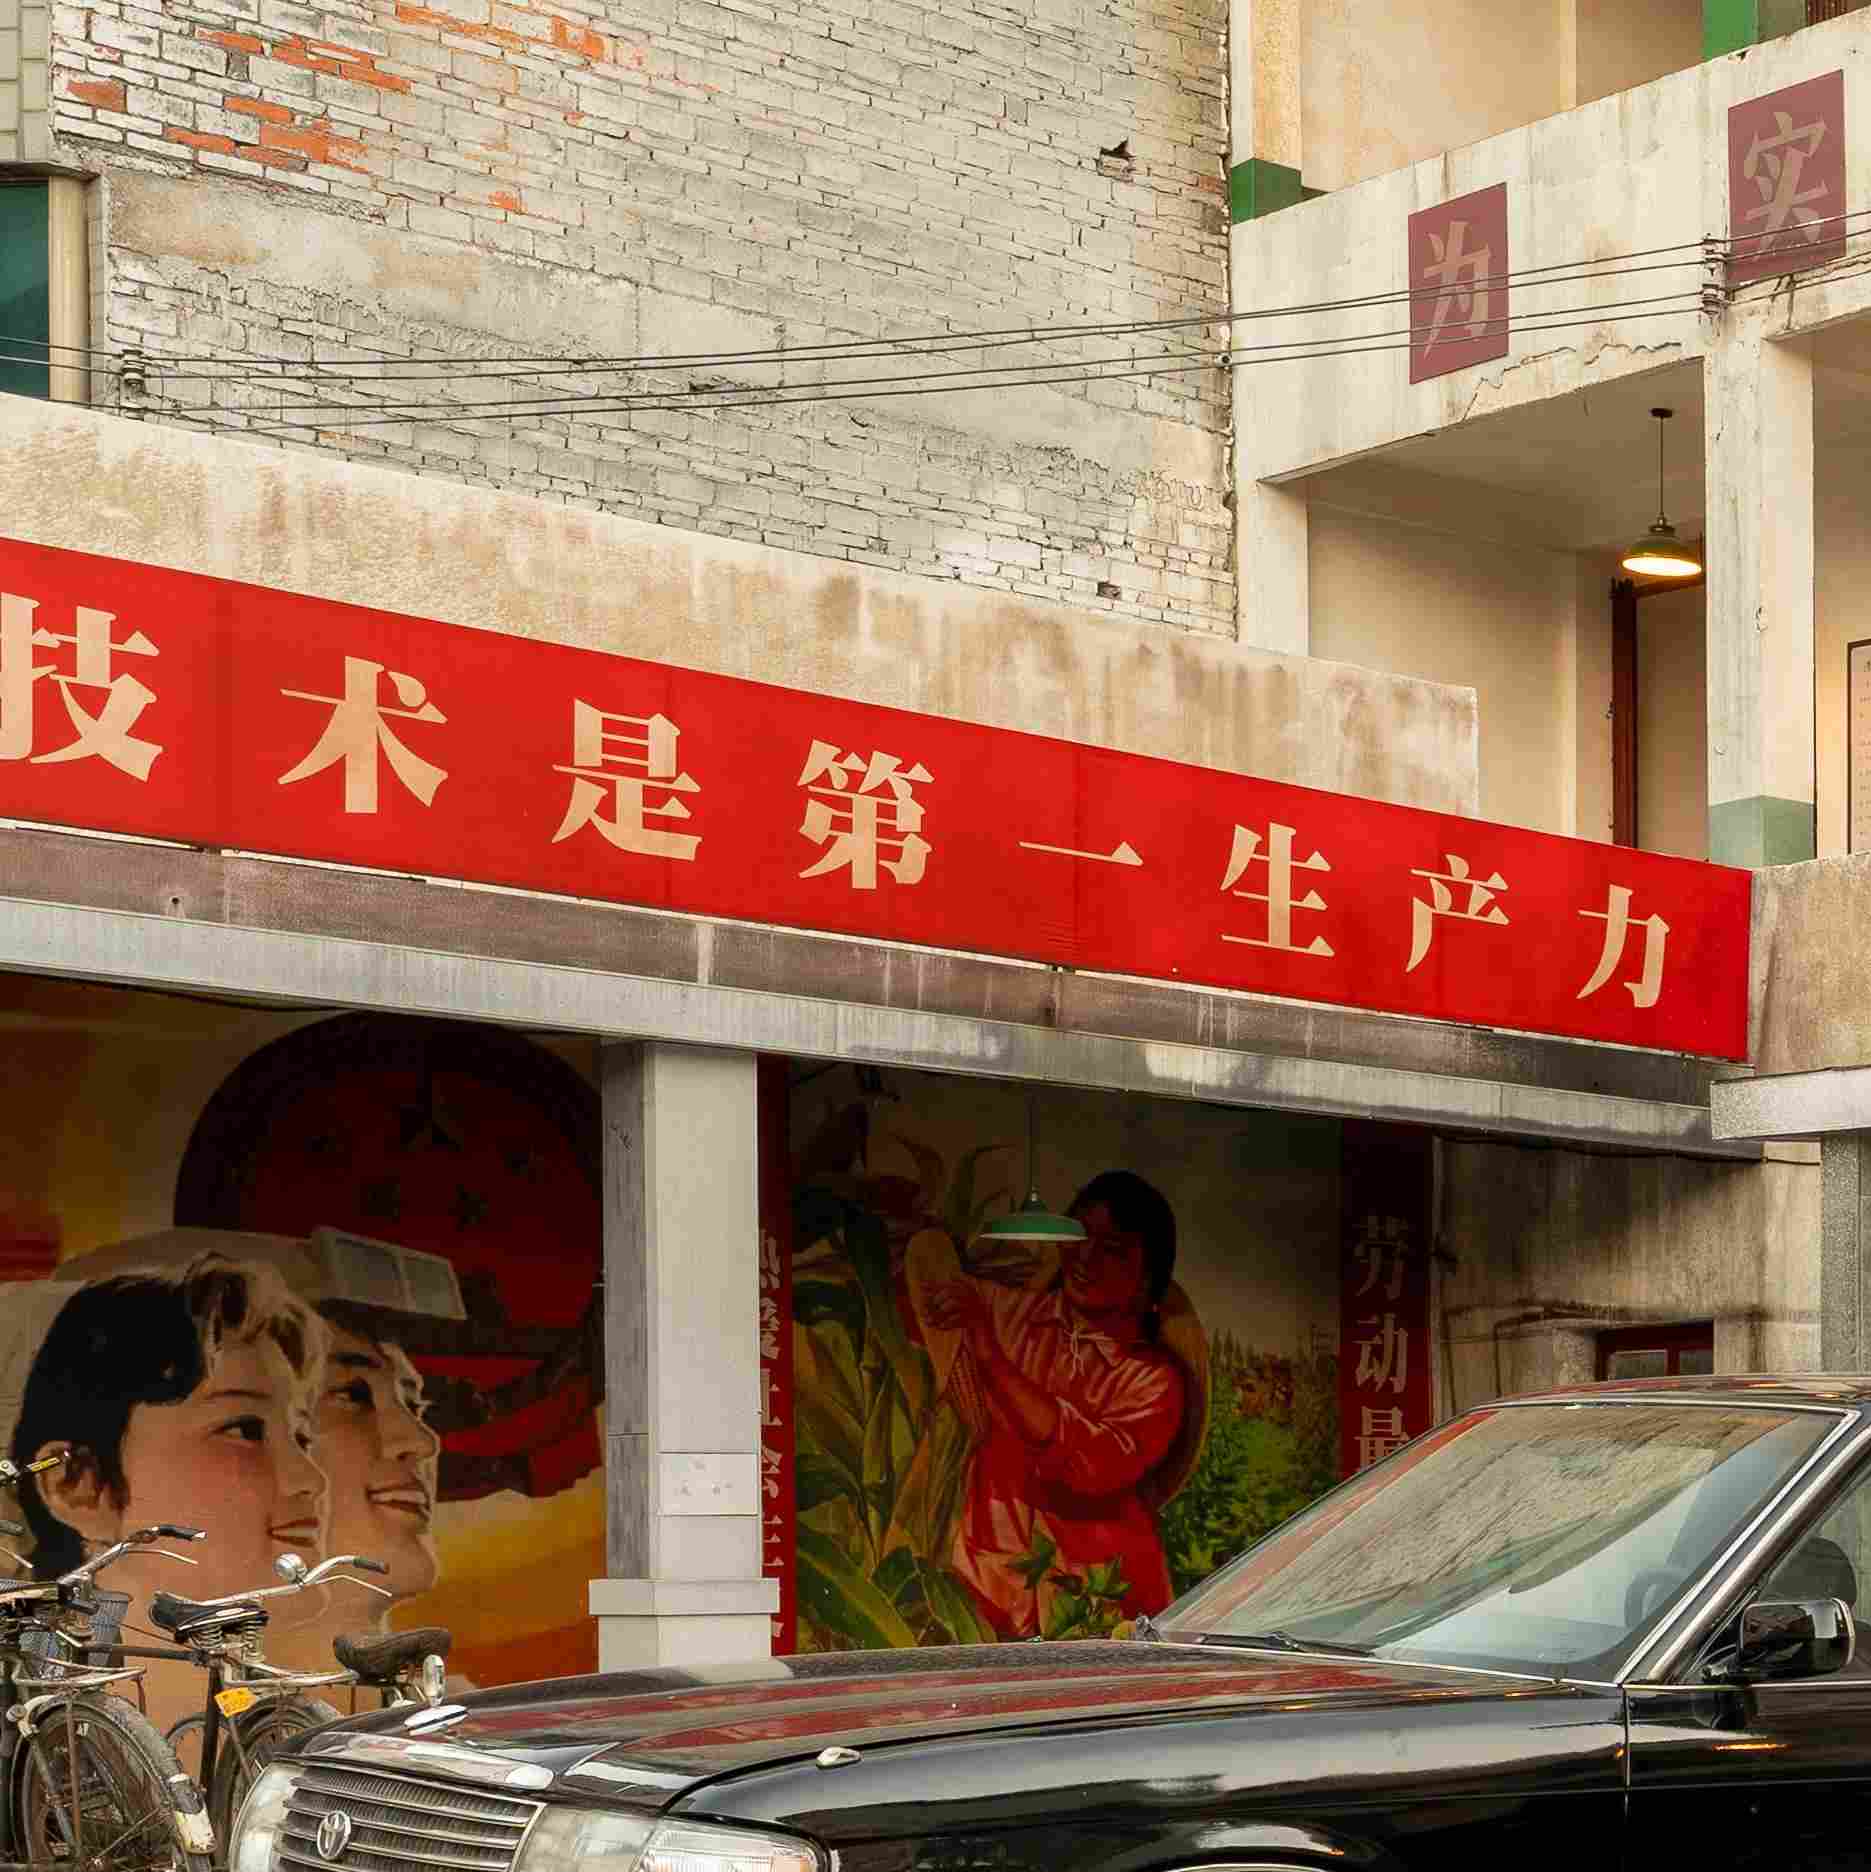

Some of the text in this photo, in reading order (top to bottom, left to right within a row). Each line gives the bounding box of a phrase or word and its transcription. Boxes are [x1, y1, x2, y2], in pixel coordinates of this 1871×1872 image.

[0, 590, 1671, 1009] 技术是第一生产力
